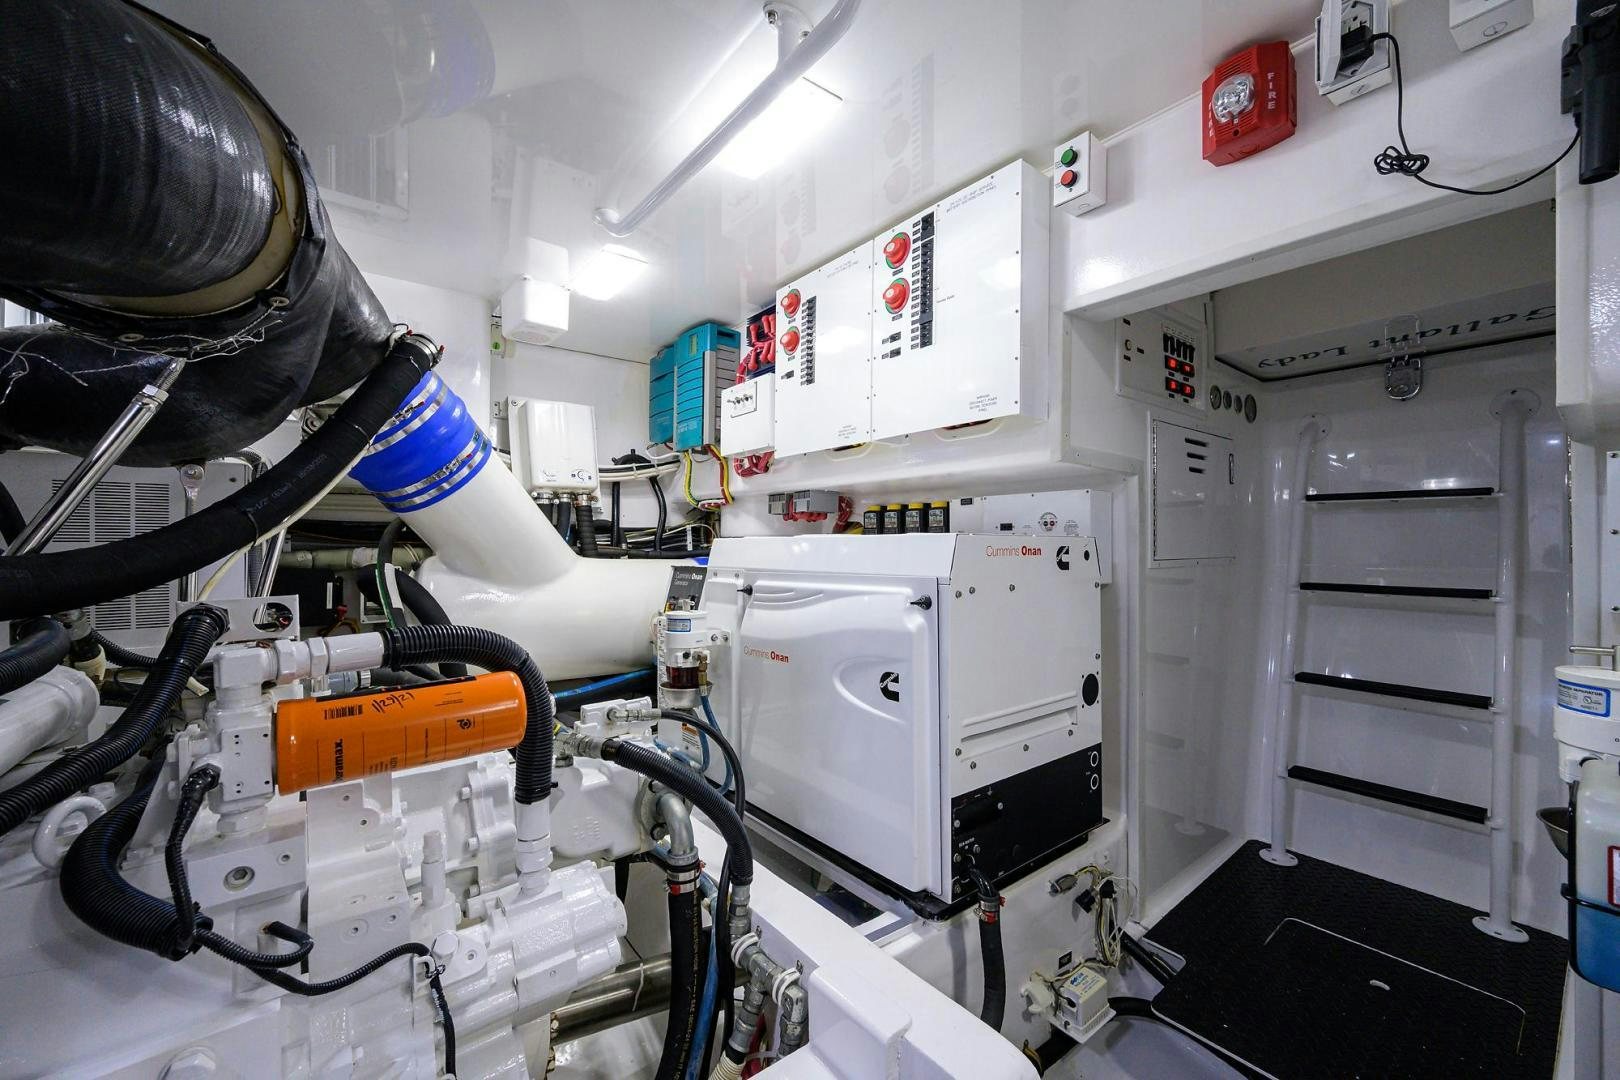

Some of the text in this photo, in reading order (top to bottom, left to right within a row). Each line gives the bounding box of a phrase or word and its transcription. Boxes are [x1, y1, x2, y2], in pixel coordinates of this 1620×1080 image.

[1267, 72, 1277, 110] FIRE
[1257, 345, 1348, 369] Lady
[986, 545, 1042, 557] Cummins Onan
[691, 572, 703, 581] Onan
[743, 645, 789, 664] Cummins Onan
